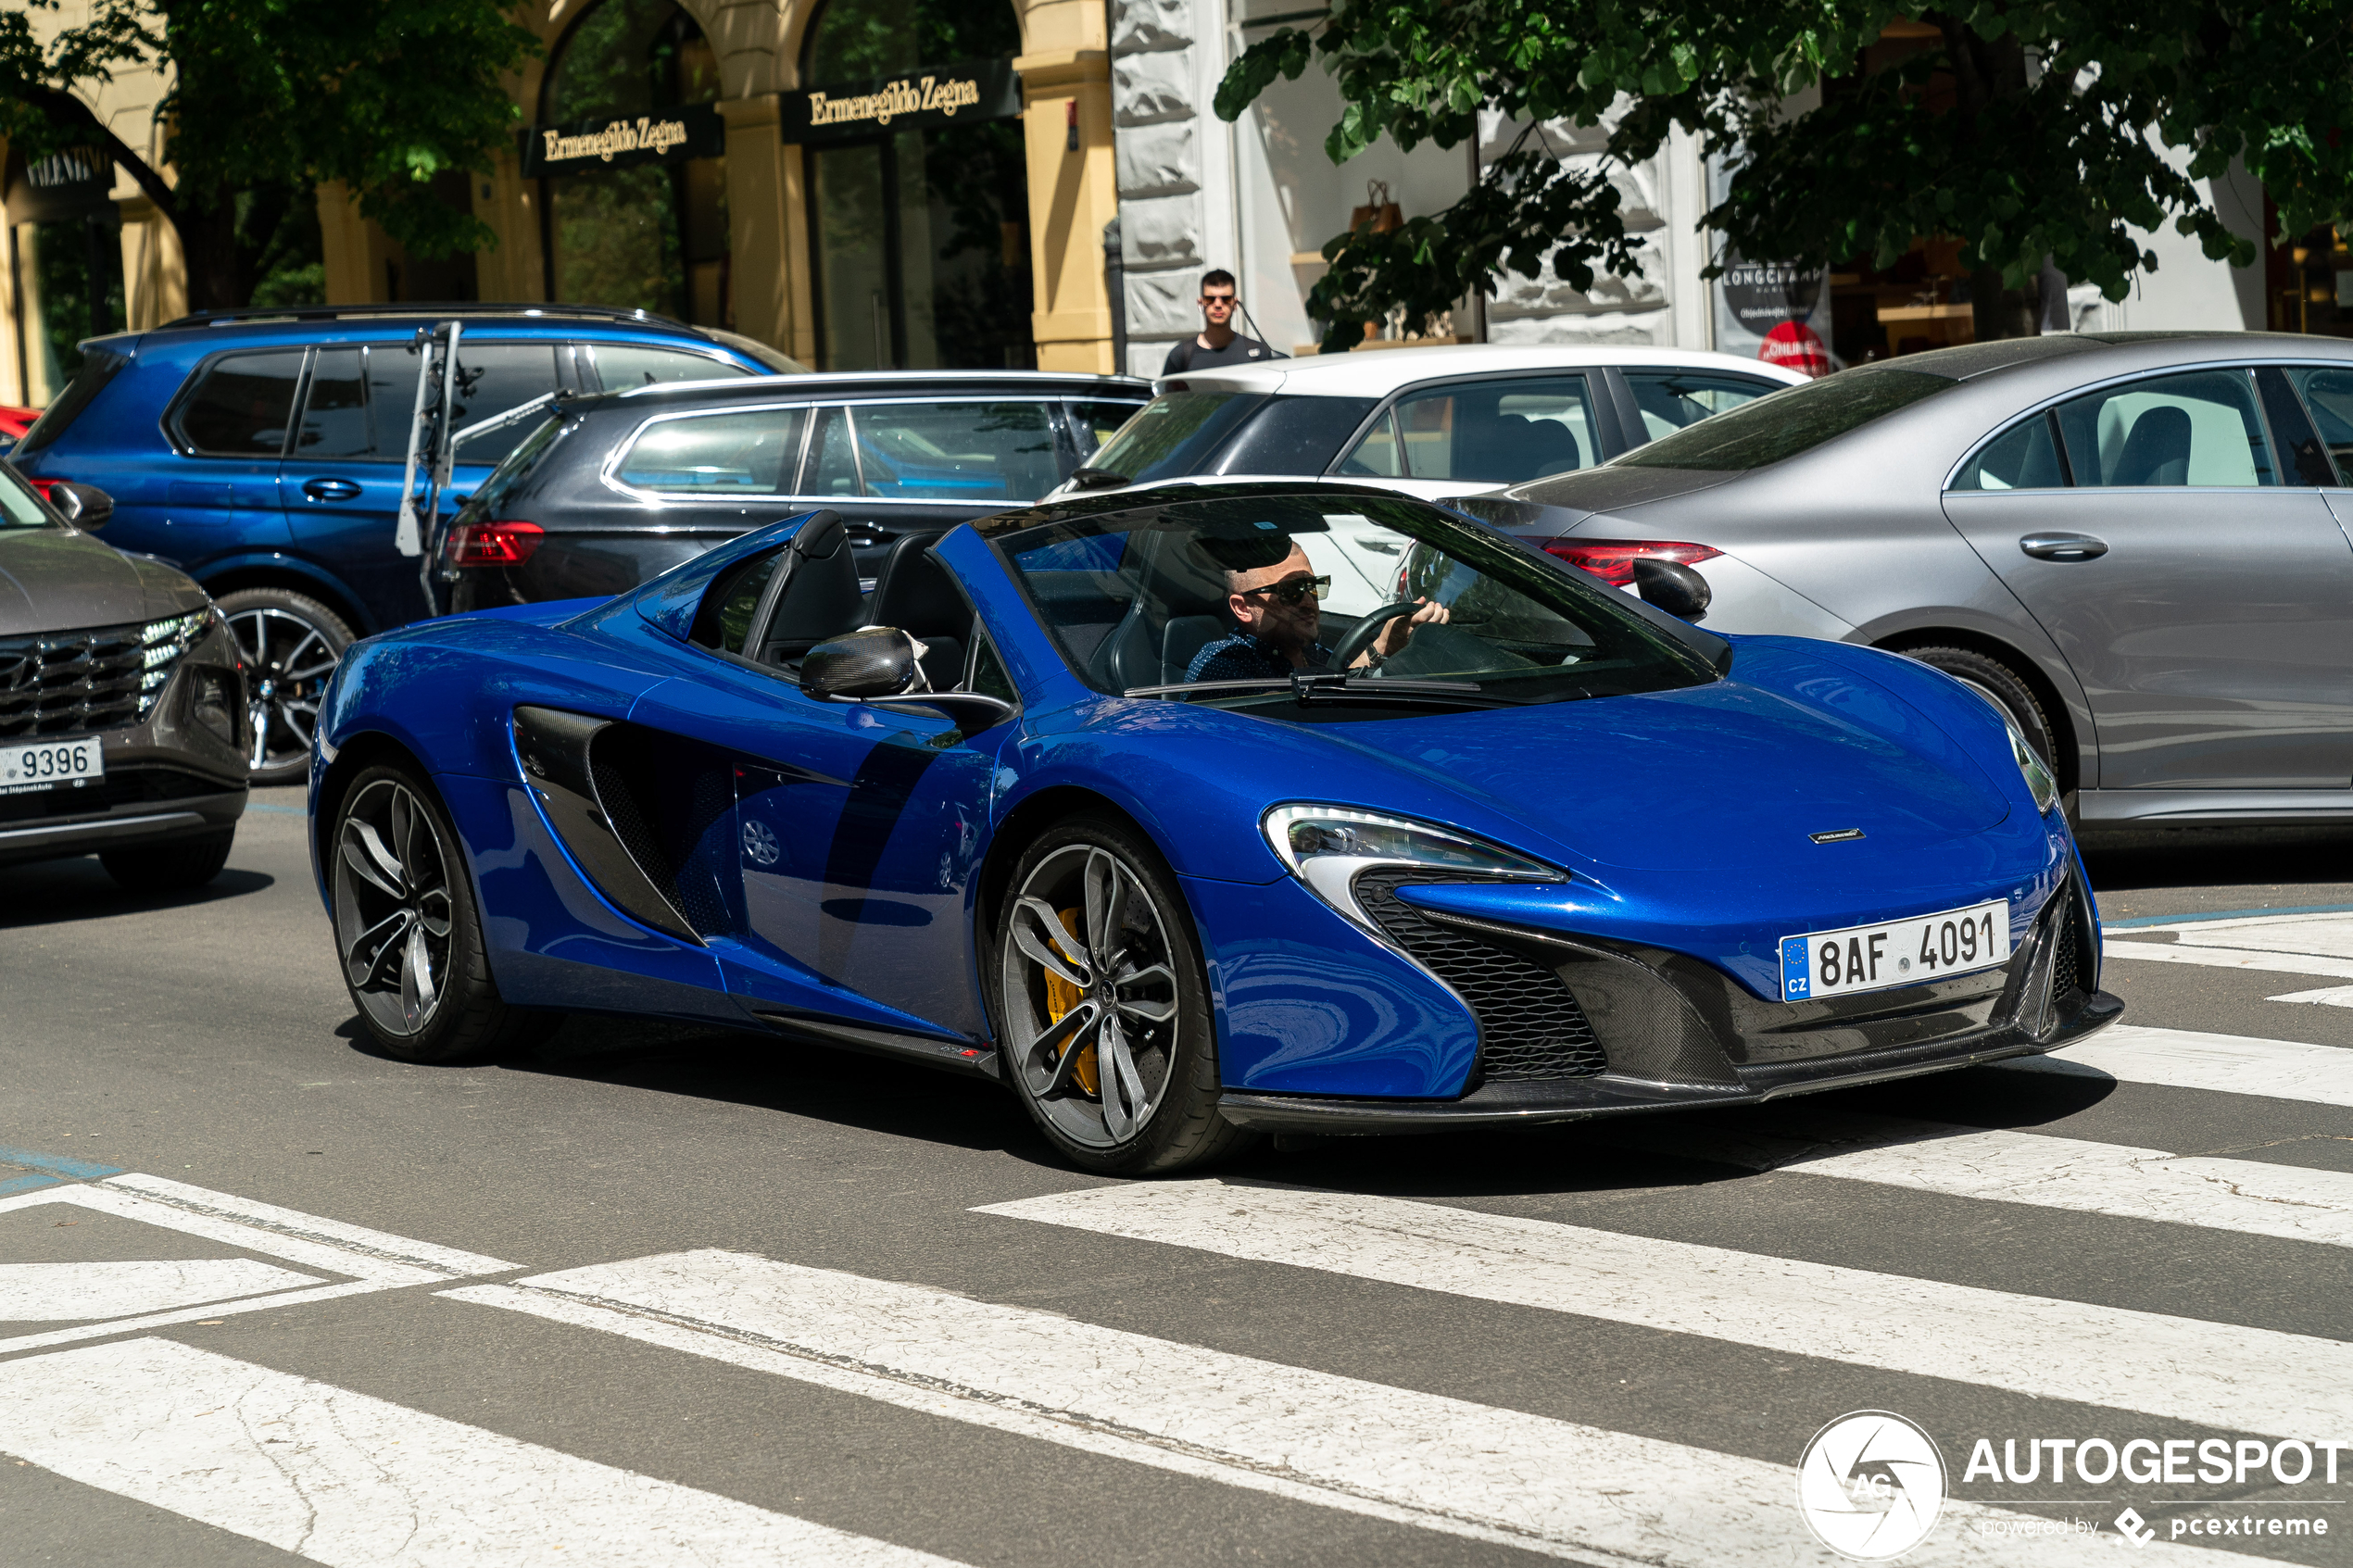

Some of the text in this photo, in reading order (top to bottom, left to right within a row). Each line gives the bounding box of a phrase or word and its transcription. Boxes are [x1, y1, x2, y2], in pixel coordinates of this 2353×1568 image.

[808, 75, 980, 126] Ermenegildo Zegna
[542, 116, 687, 163] Ermenegildo Zegna
[21, 746, 88, 778] 9396
[1819, 912, 1994, 986] 8AF 4091
[1788, 977, 1807, 993] CZ
